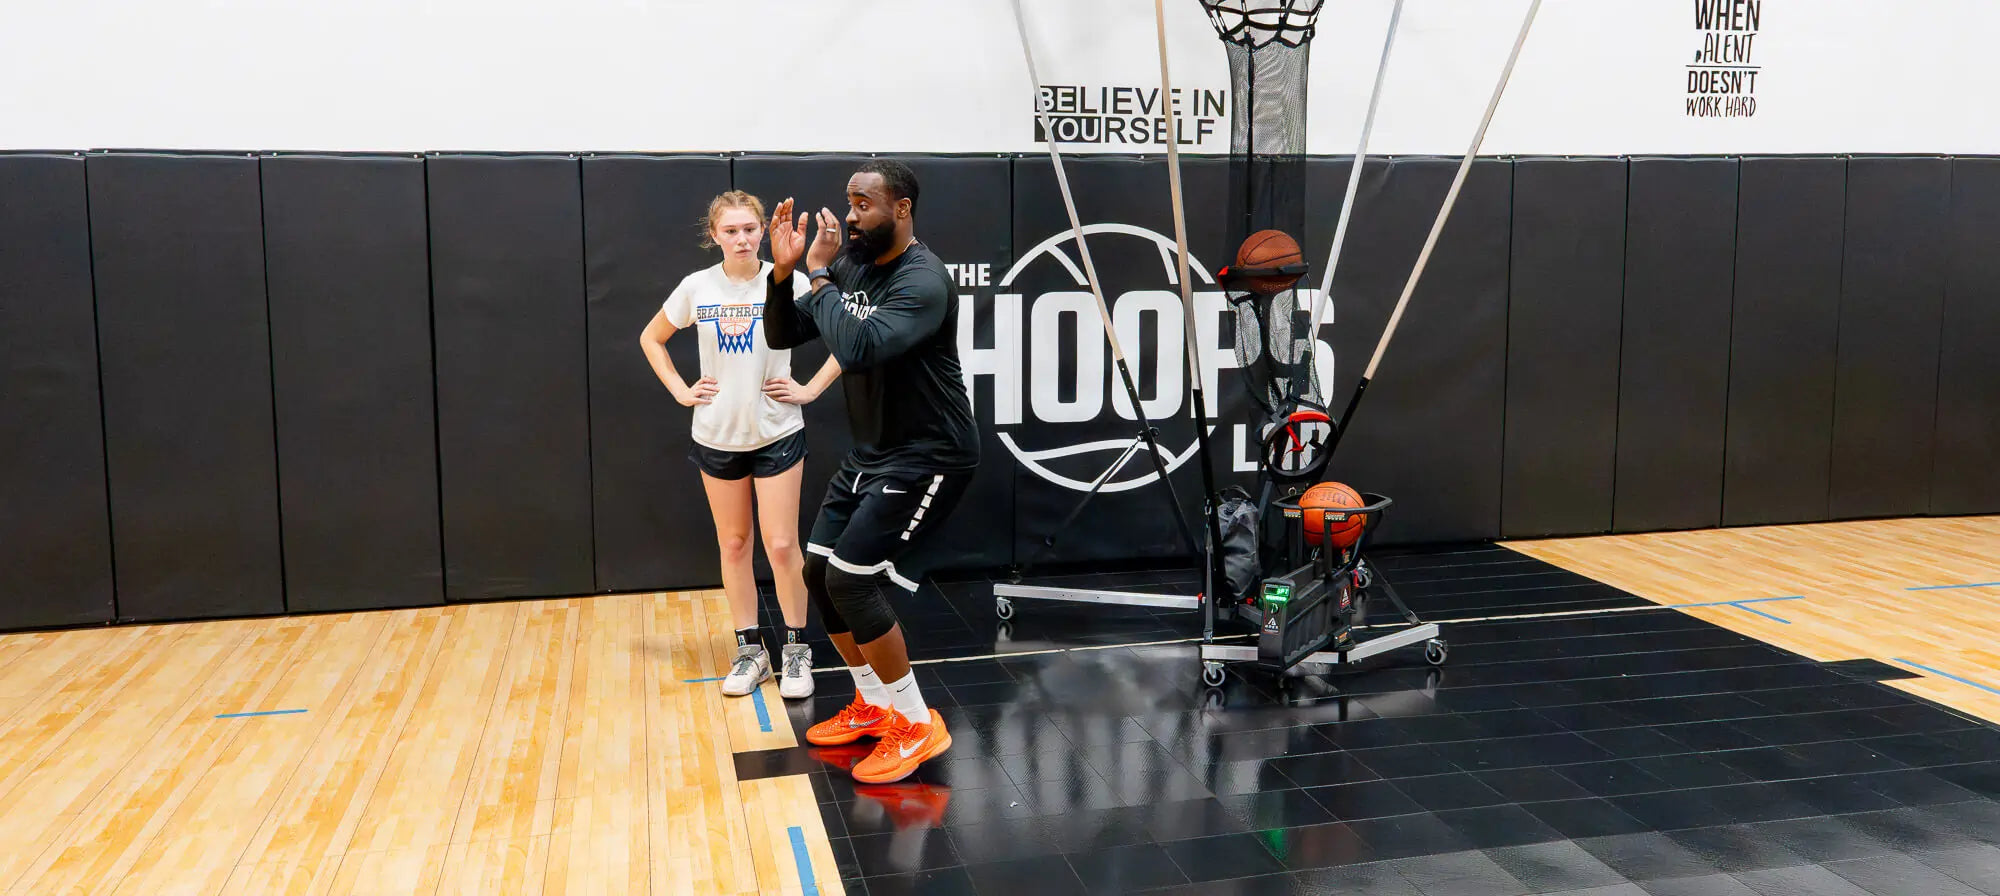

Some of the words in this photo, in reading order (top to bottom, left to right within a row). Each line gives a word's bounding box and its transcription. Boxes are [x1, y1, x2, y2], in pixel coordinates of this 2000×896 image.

[1695, 0, 1760, 31] WHEN
[1687, 70, 1758, 94] DOESN'T
[1034, 86, 1182, 116] BELIEVE
[1193, 89, 1225, 117] IN
[1686, 96, 1721, 117] WORK
[1725, 96, 1756, 117] HARD
[1034, 116, 1215, 145] YOURSELF
[944, 263, 991, 287] THE
[956, 289, 1335, 425] HOOPS
